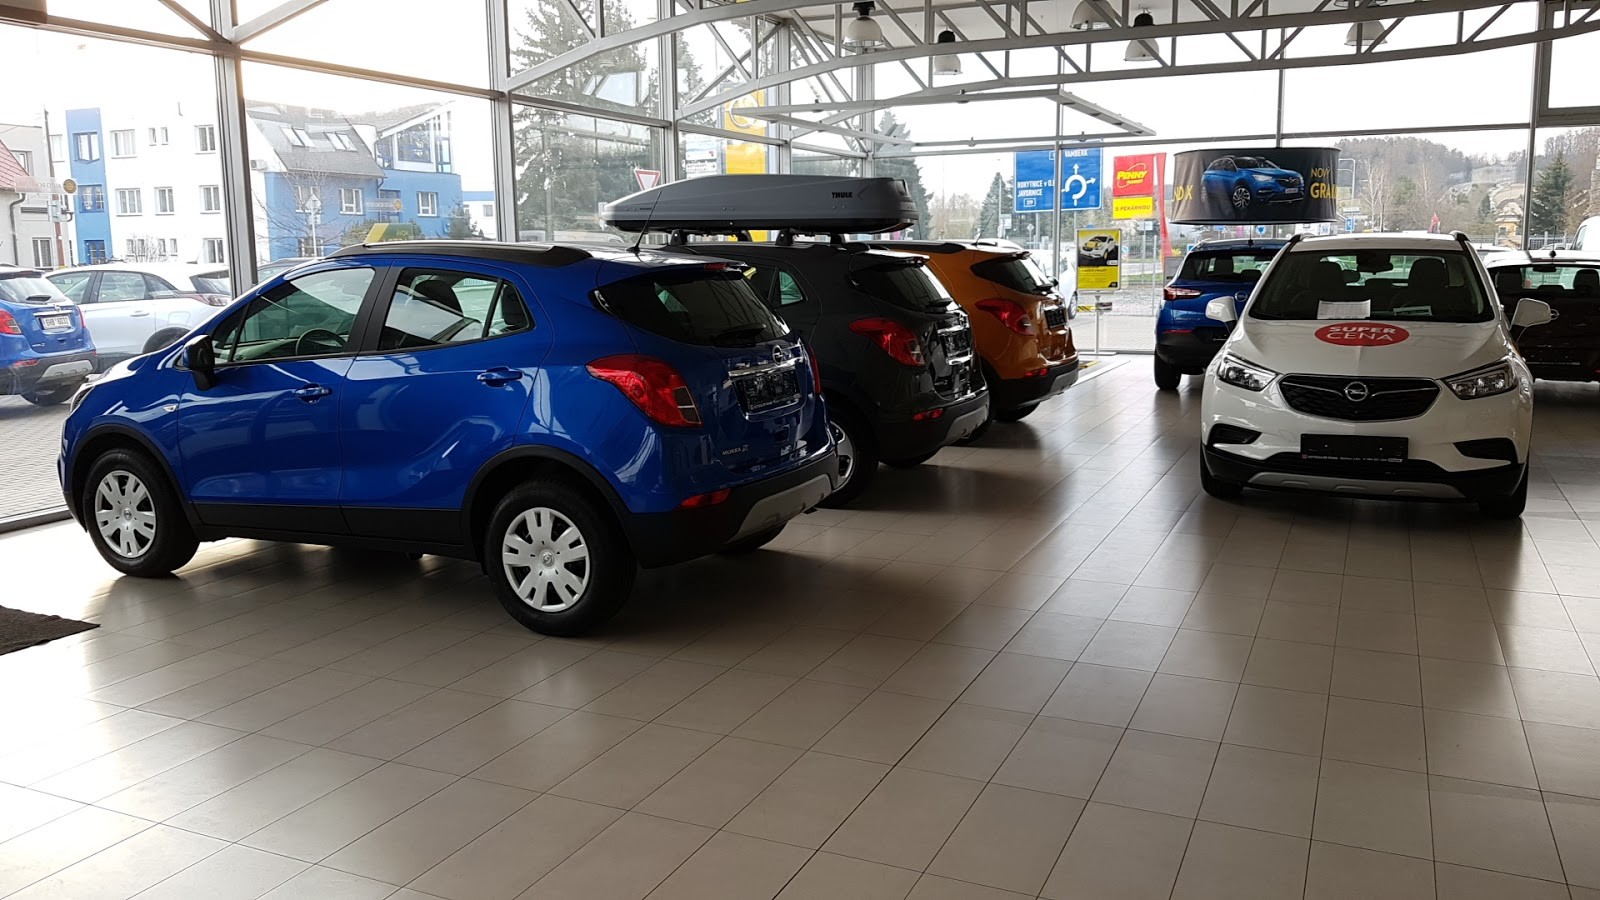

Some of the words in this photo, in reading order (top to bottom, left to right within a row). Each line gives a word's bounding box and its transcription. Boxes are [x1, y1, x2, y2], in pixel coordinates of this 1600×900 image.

[1065, 148, 1088, 157] VAMBERK
[1117, 170, 1148, 180] PENNY
[1311, 166, 1331, 178] NOVÝ
[1017, 180, 1043, 188] ROKYTNICE
[1185, 184, 1194, 200] X
[1328, 326, 1396, 334] SUPER
[1326, 332, 1393, 341] CENA
